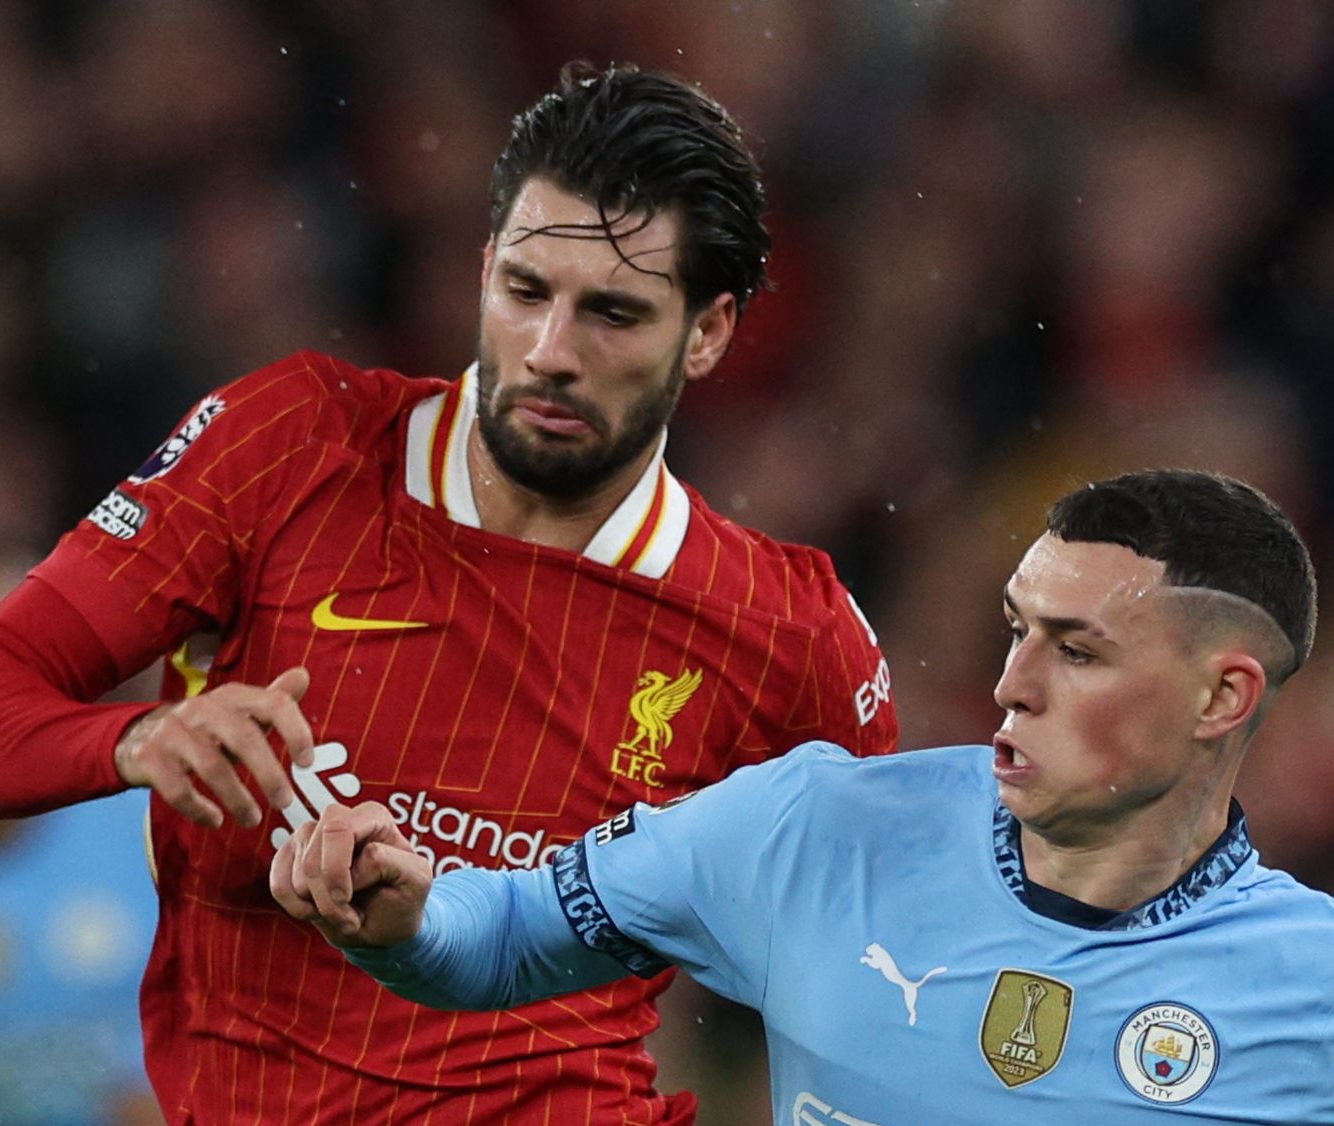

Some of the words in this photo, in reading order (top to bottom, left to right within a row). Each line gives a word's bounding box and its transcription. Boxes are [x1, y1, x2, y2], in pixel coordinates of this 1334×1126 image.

[1132, 1009, 1211, 1051] MANCHESTER
[1000, 1042, 1037, 1063] FIFA
[1143, 1085, 1173, 1099] CITY
